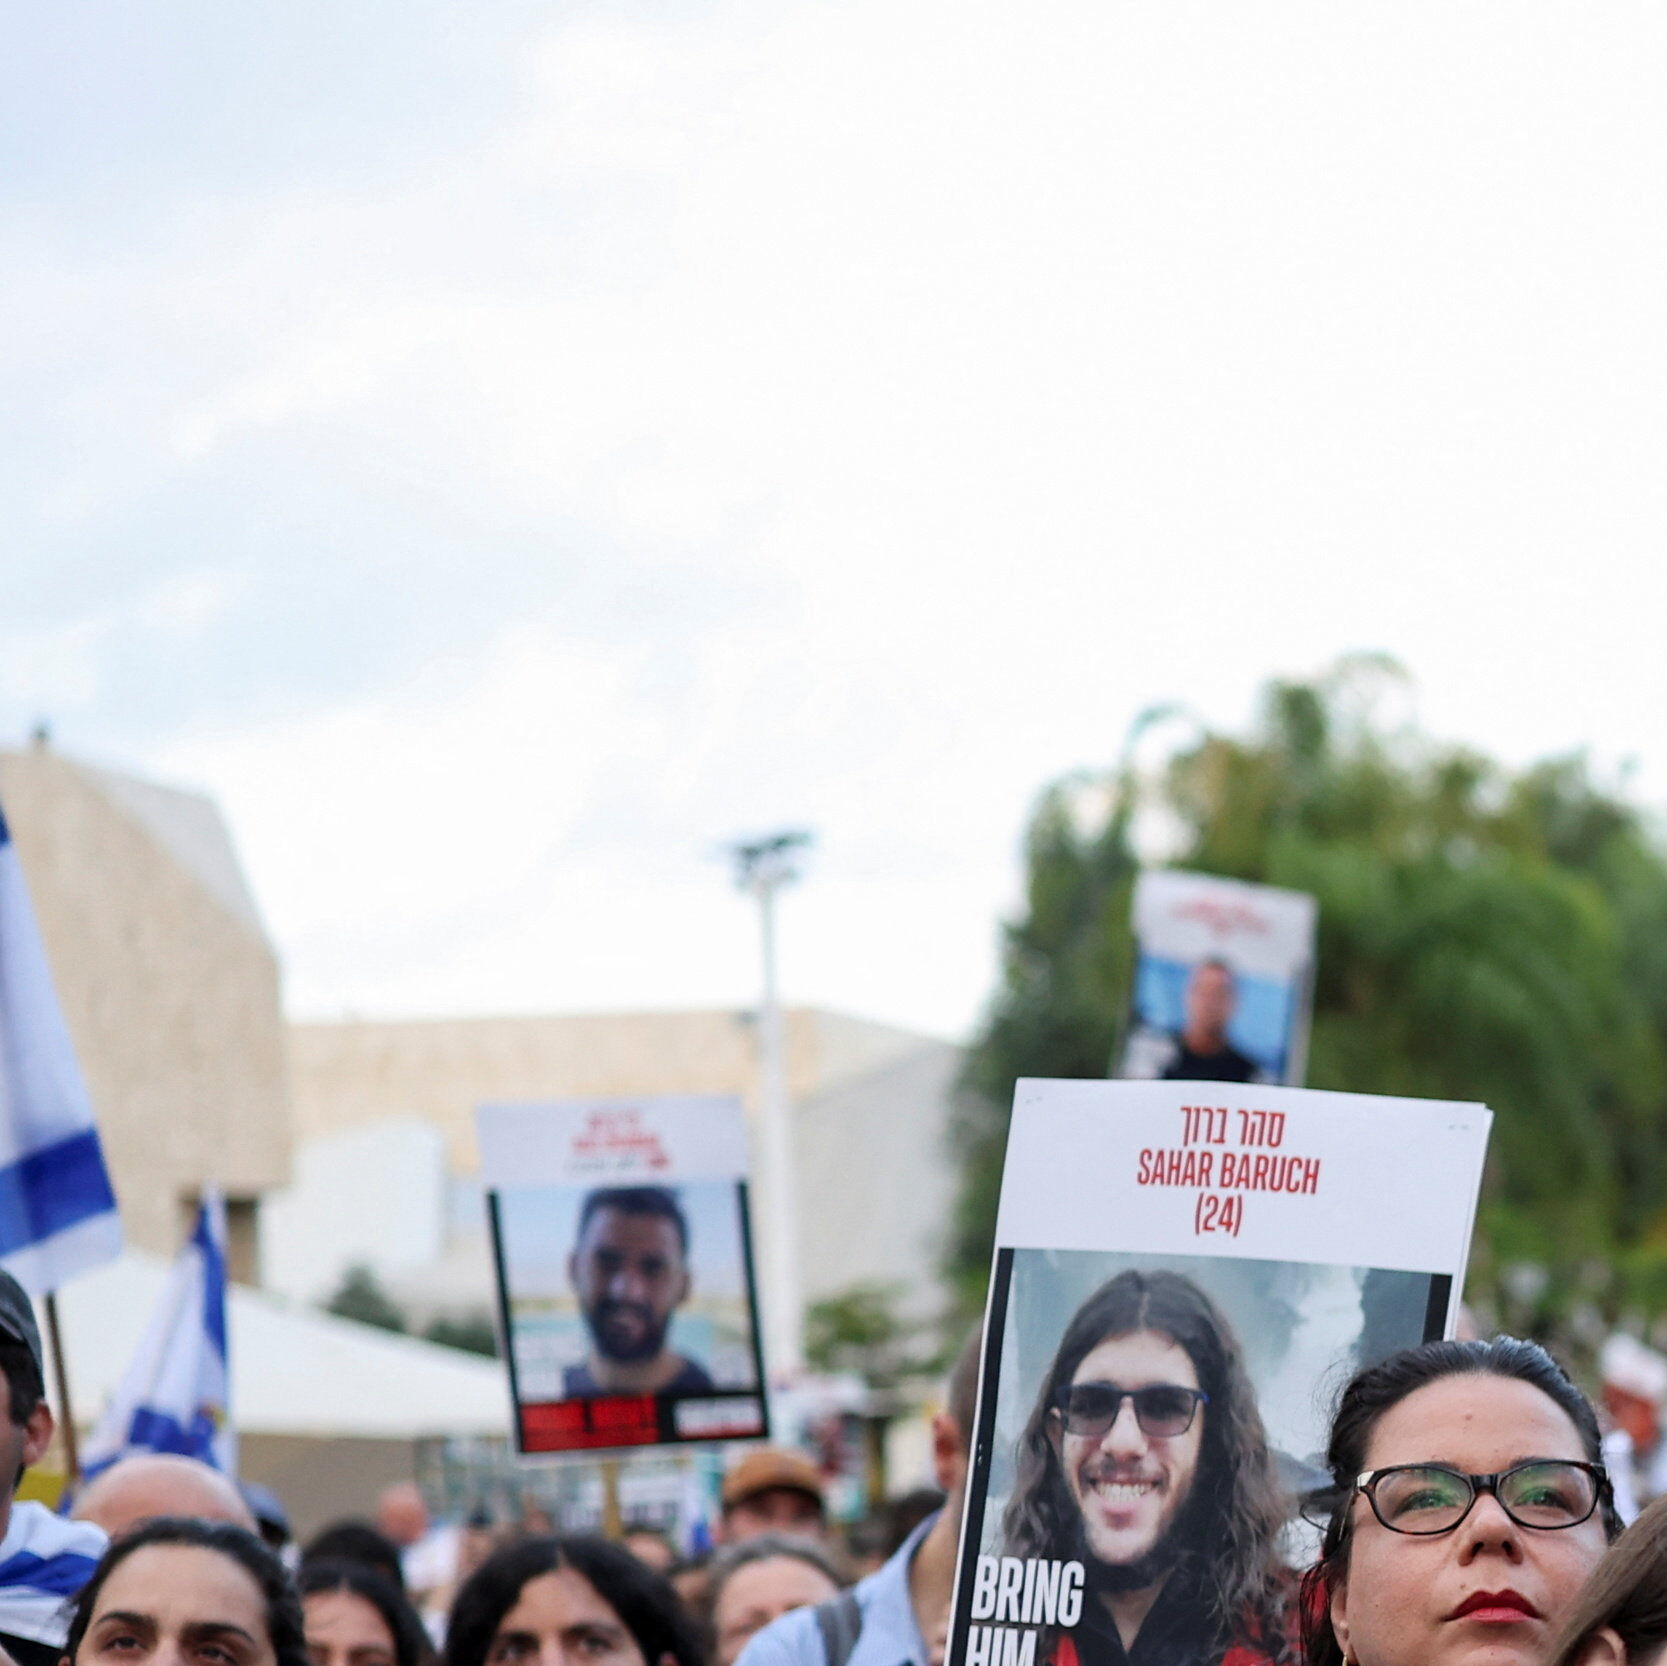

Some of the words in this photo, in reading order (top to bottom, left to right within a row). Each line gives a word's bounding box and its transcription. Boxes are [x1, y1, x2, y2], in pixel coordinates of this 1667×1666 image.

[1180, 1105, 1228, 1148] ברוך
[1237, 1108, 1286, 1148] סהר
[1137, 1148, 1213, 1188] SAHAR
[1219, 1152, 1321, 1195] BARUCH
[1195, 1192, 1243, 1238] (24)
[970, 1555, 1085, 1628] BRING
